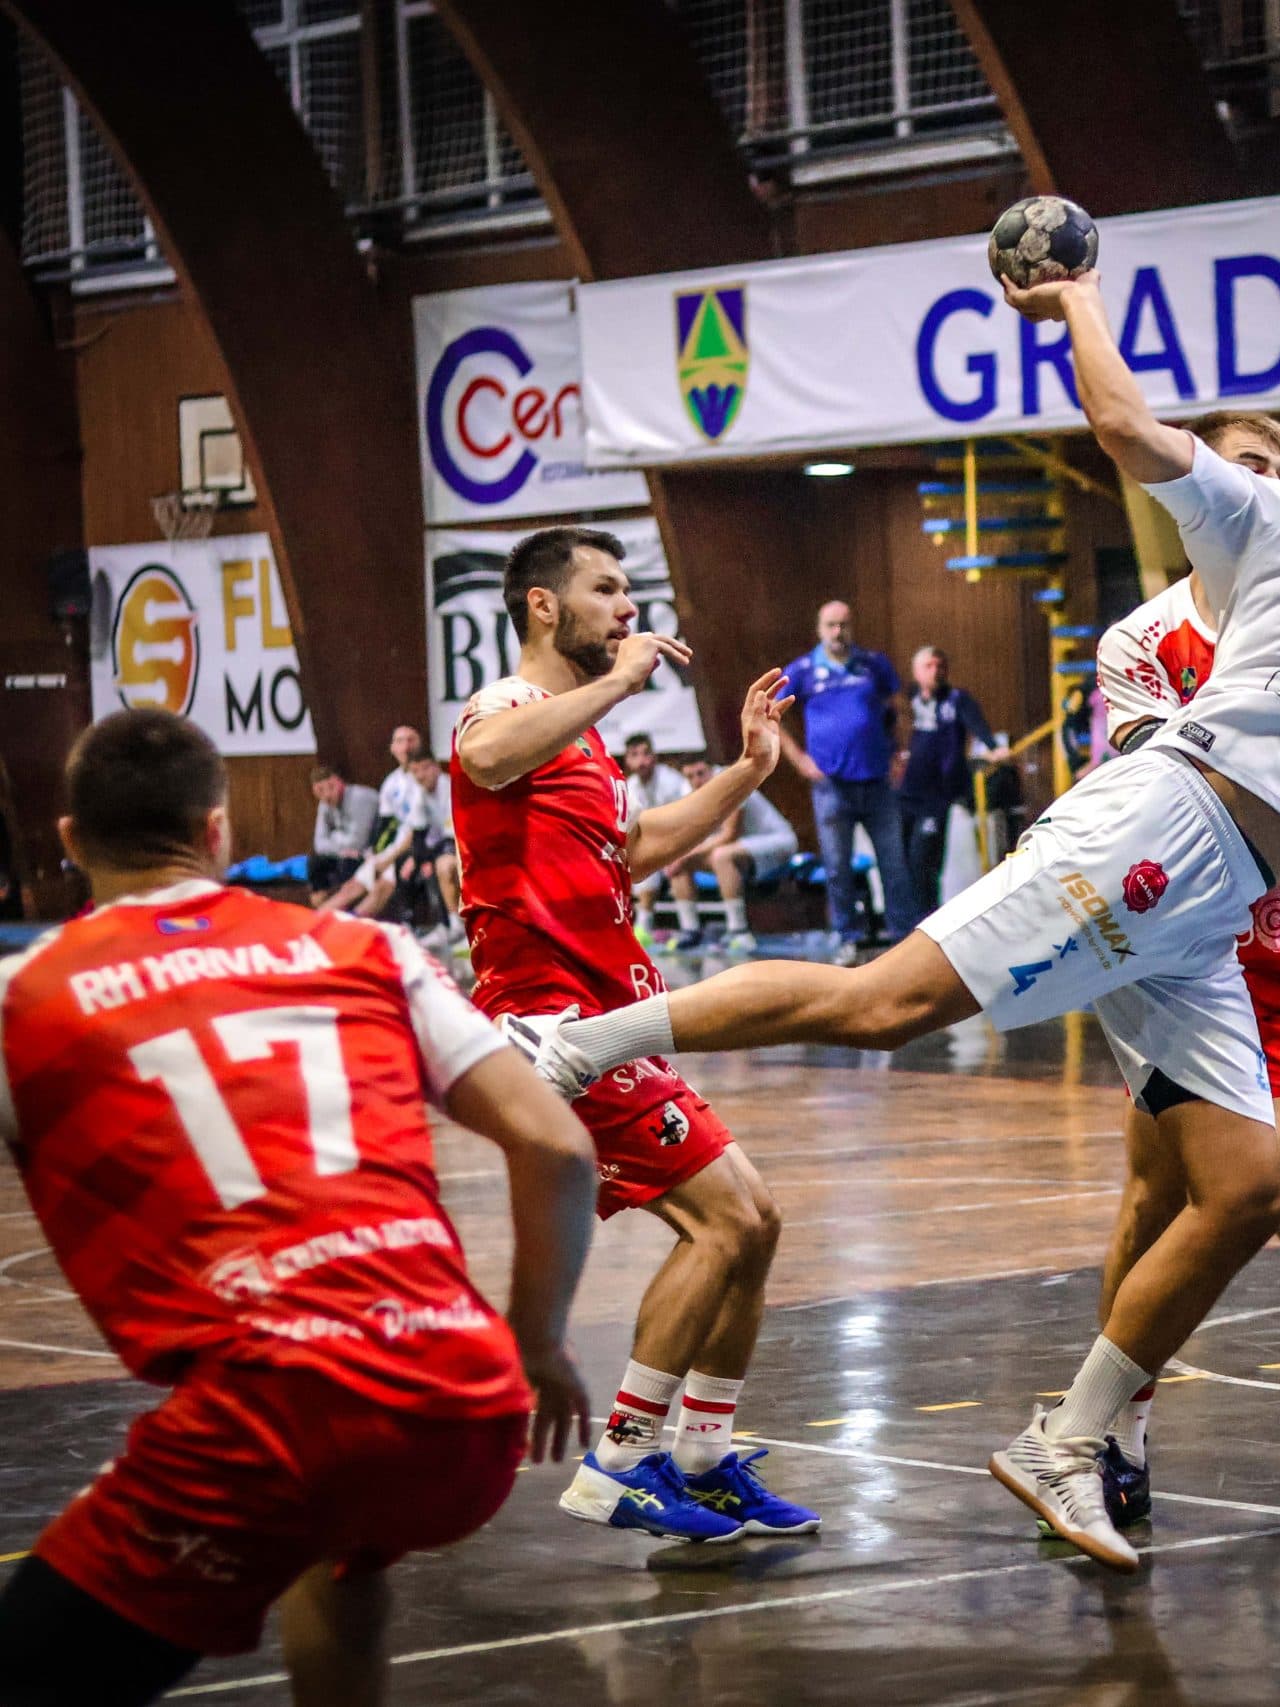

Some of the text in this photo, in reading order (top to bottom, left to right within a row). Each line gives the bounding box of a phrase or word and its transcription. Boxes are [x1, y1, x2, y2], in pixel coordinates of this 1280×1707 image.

[1058, 872, 1138, 965] ISOMAX
[1009, 960, 1053, 996] 4
[127, 1005, 362, 1211] 17
